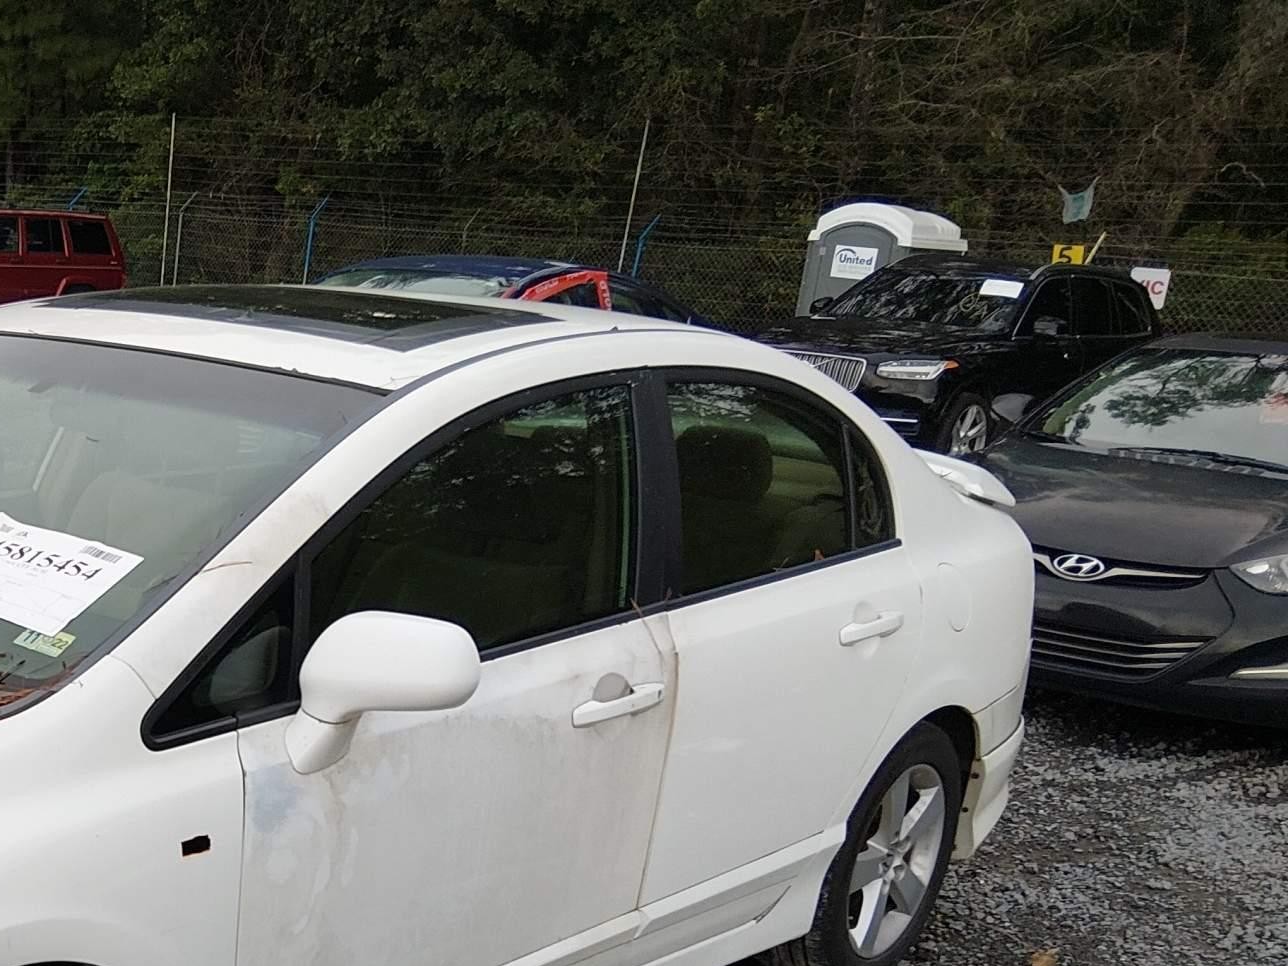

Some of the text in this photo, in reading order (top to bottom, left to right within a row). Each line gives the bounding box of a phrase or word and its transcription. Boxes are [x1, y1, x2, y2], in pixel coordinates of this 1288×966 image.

[839, 252, 874, 266] United
[1058, 246, 1073, 265] 5
[51, 638, 69, 650] 22
